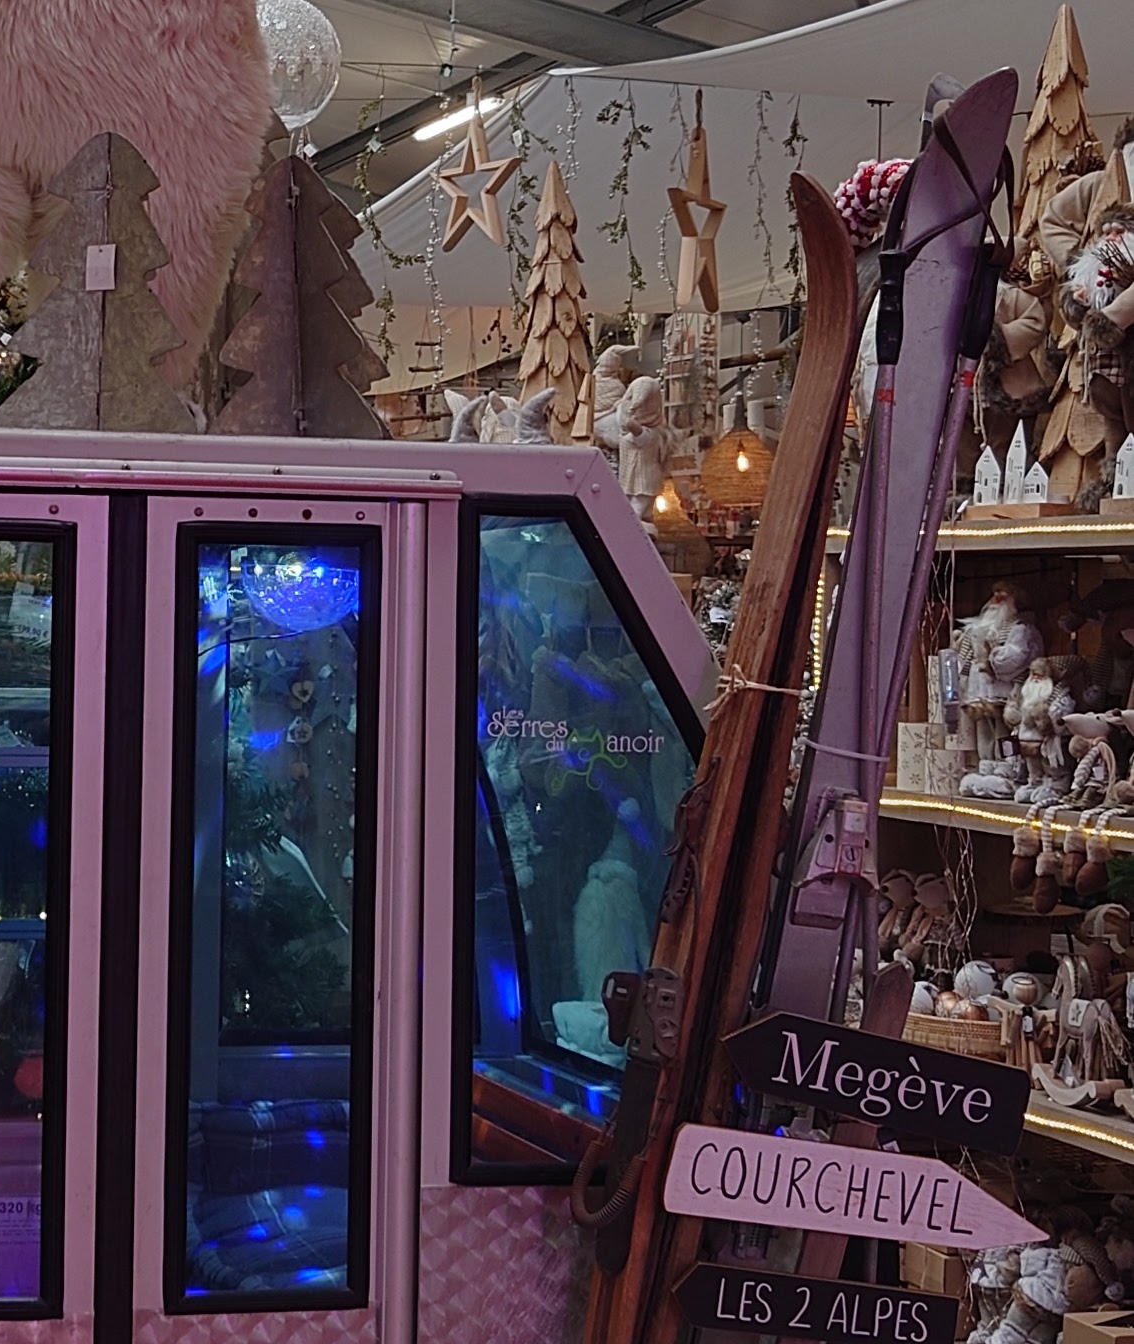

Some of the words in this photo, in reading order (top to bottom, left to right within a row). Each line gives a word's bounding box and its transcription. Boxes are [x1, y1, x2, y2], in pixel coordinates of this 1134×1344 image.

[487, 711, 568, 738] Serres
[502, 706, 524, 720] Les
[545, 736, 564, 752] du
[771, 1031, 994, 1126] Megève
[690, 1141, 975, 1236] COURCHEVEL
[0, 1201, 24, 1214] 320
[715, 1277, 773, 1325] LES
[788, 1286, 812, 1330] 2
[826, 1291, 929, 1344] ALPES
